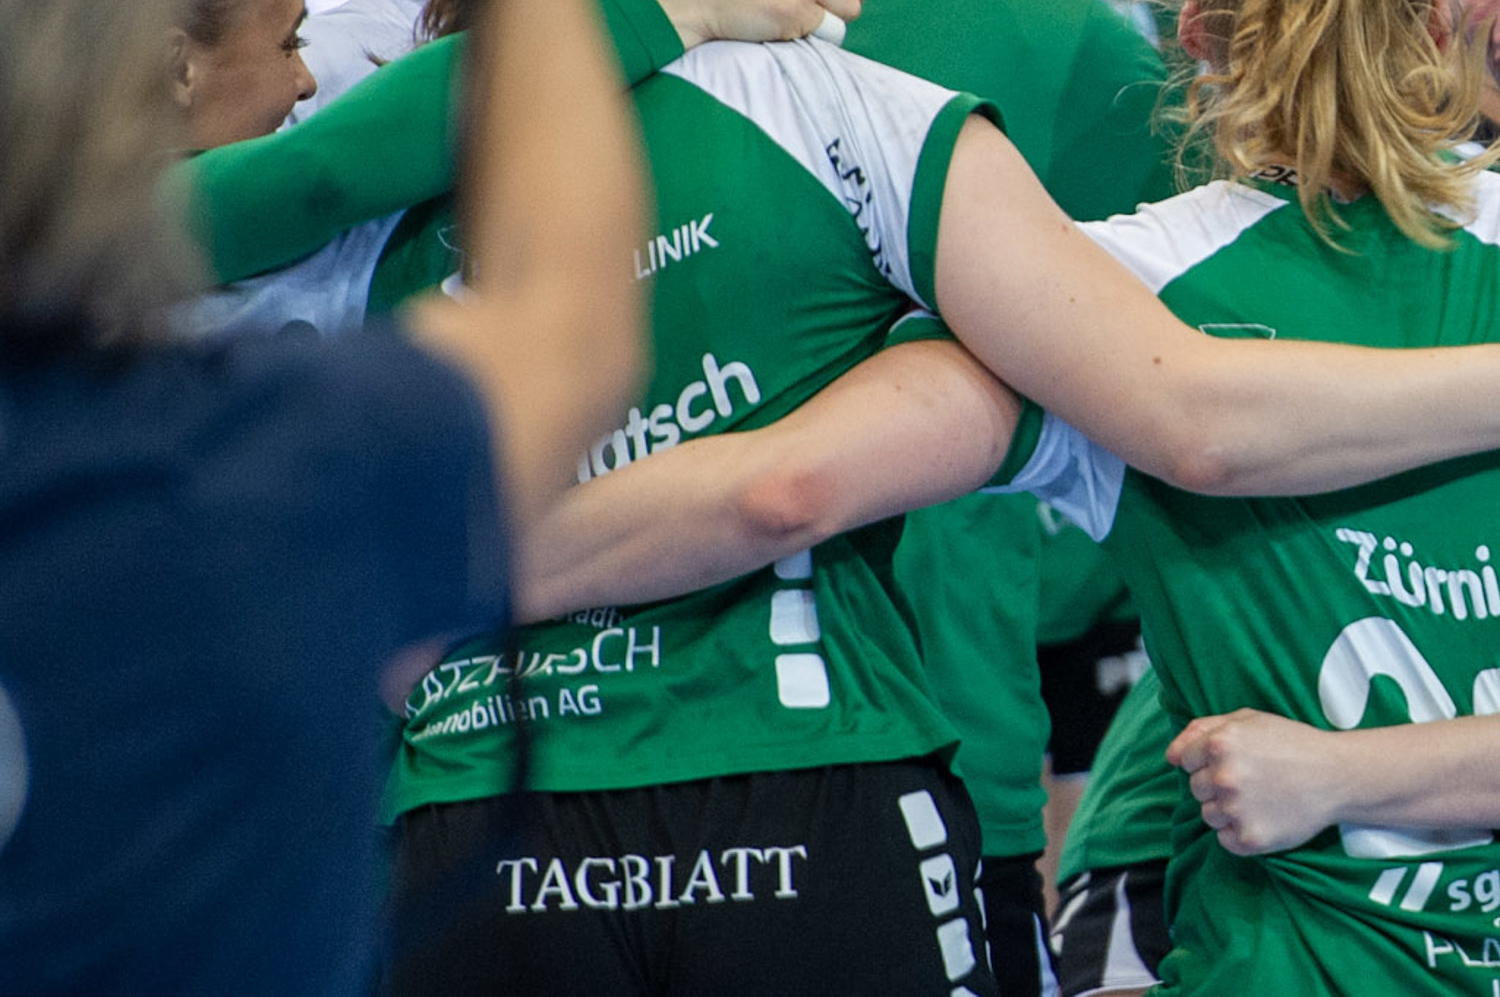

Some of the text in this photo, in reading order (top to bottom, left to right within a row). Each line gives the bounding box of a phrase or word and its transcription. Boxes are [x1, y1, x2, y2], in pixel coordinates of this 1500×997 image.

[633, 212, 720, 280] LINIK
[558, 684, 602, 716] AG
[495, 844, 808, 914] TAGBLATT
